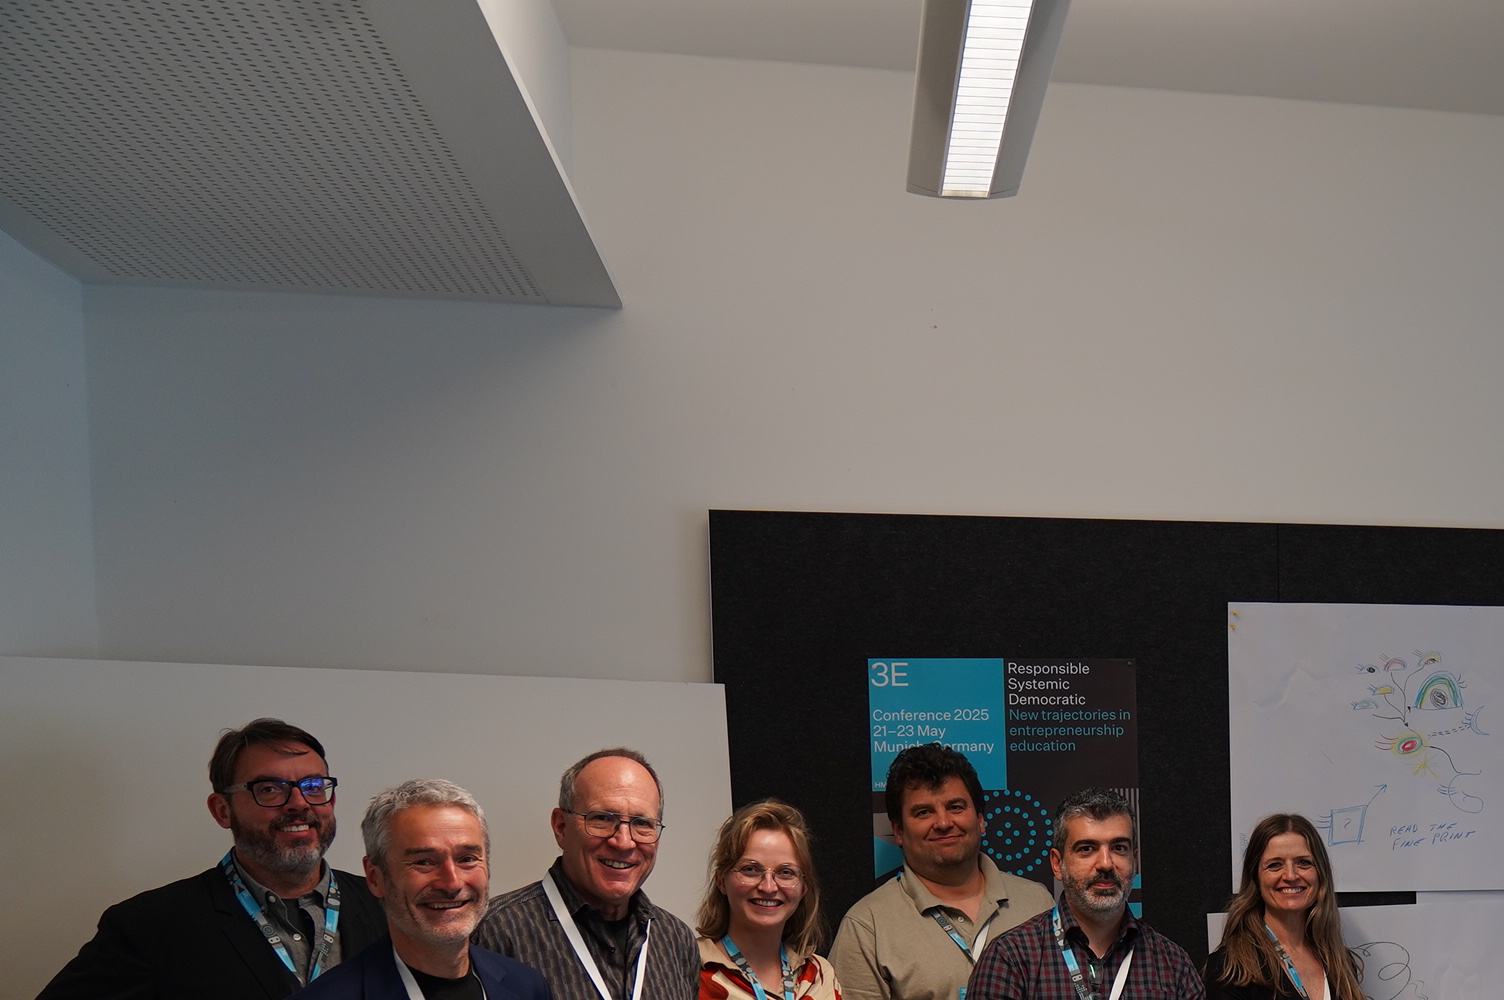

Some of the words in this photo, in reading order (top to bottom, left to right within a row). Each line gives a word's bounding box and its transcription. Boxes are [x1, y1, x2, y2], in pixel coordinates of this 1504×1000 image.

[871, 662, 909, 687] 3E
[1008, 662, 1090, 676] Responsible
[1008, 678, 1070, 692] Systemic
[1009, 693, 1086, 705] Democratic
[872, 709, 951, 721] Conference
[954, 709, 989, 721] 2025
[1009, 709, 1039, 720] New
[1041, 709, 1116, 723] trajectories
[1119, 709, 1131, 720] in
[917, 725, 946, 739] May
[1009, 724, 1124, 738] entrepreneurship
[1009, 740, 1076, 752] education
[1390, 824, 1418, 836] READ
[1430, 822, 1457, 831] THE
[1392, 838, 1426, 850] FINE
[1432, 831, 1476, 844] PRINT
